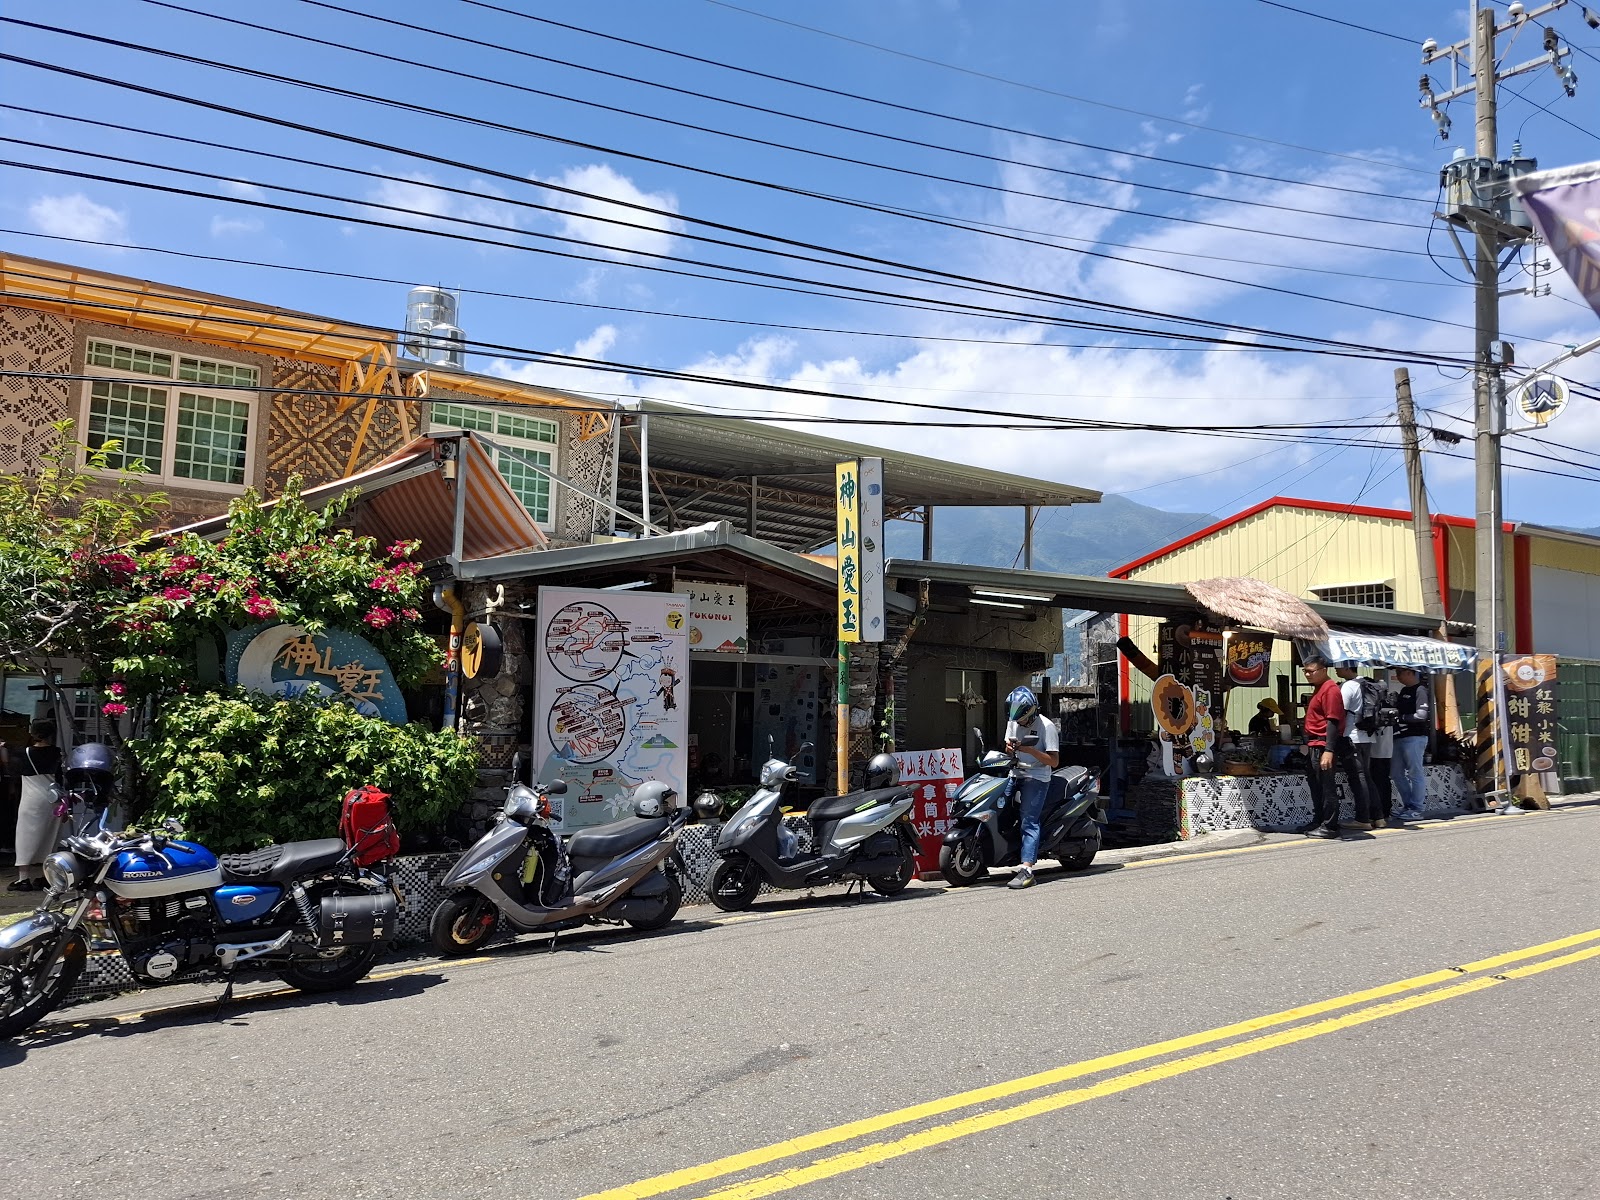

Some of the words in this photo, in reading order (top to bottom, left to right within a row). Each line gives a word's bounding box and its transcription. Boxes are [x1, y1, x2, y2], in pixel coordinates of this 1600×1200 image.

[839, 471, 858, 633] 神山愛玉
[1508, 694, 1532, 771] 甜甜圈
[123, 870, 164, 878] HONDA
